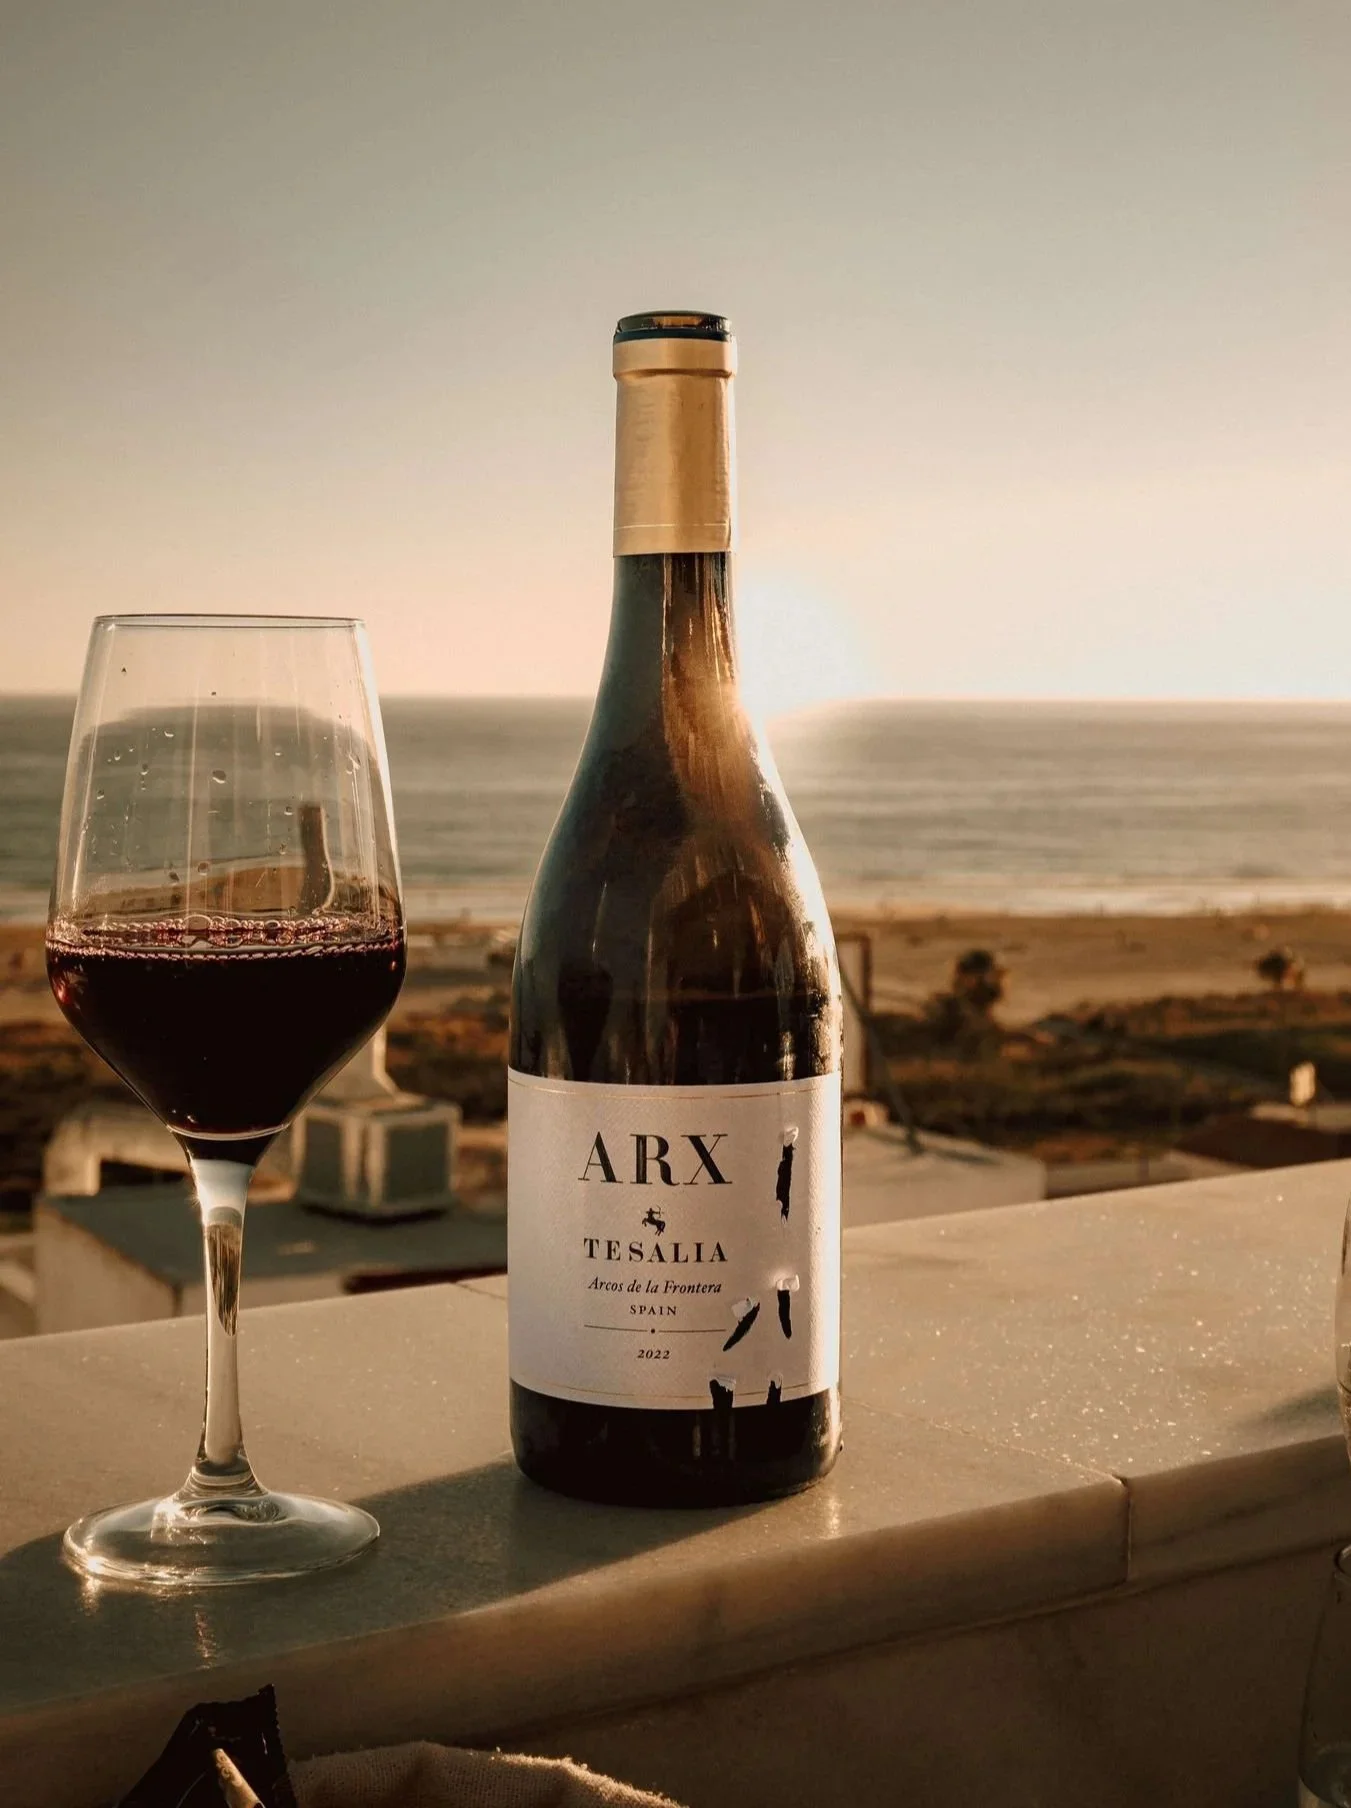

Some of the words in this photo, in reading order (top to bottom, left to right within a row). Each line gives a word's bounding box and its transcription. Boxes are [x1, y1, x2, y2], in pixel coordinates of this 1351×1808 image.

[577, 1131, 733, 1186] ARX
[583, 1238, 728, 1263] TESALIA
[588, 1276, 623, 1293] Arcos
[627, 1279, 642, 1294] de
[646, 1280, 659, 1294] la
[663, 1279, 722, 1295] Frontera
[629, 1304, 677, 1316] SPAIN
[637, 1348, 671, 1360] 2022
